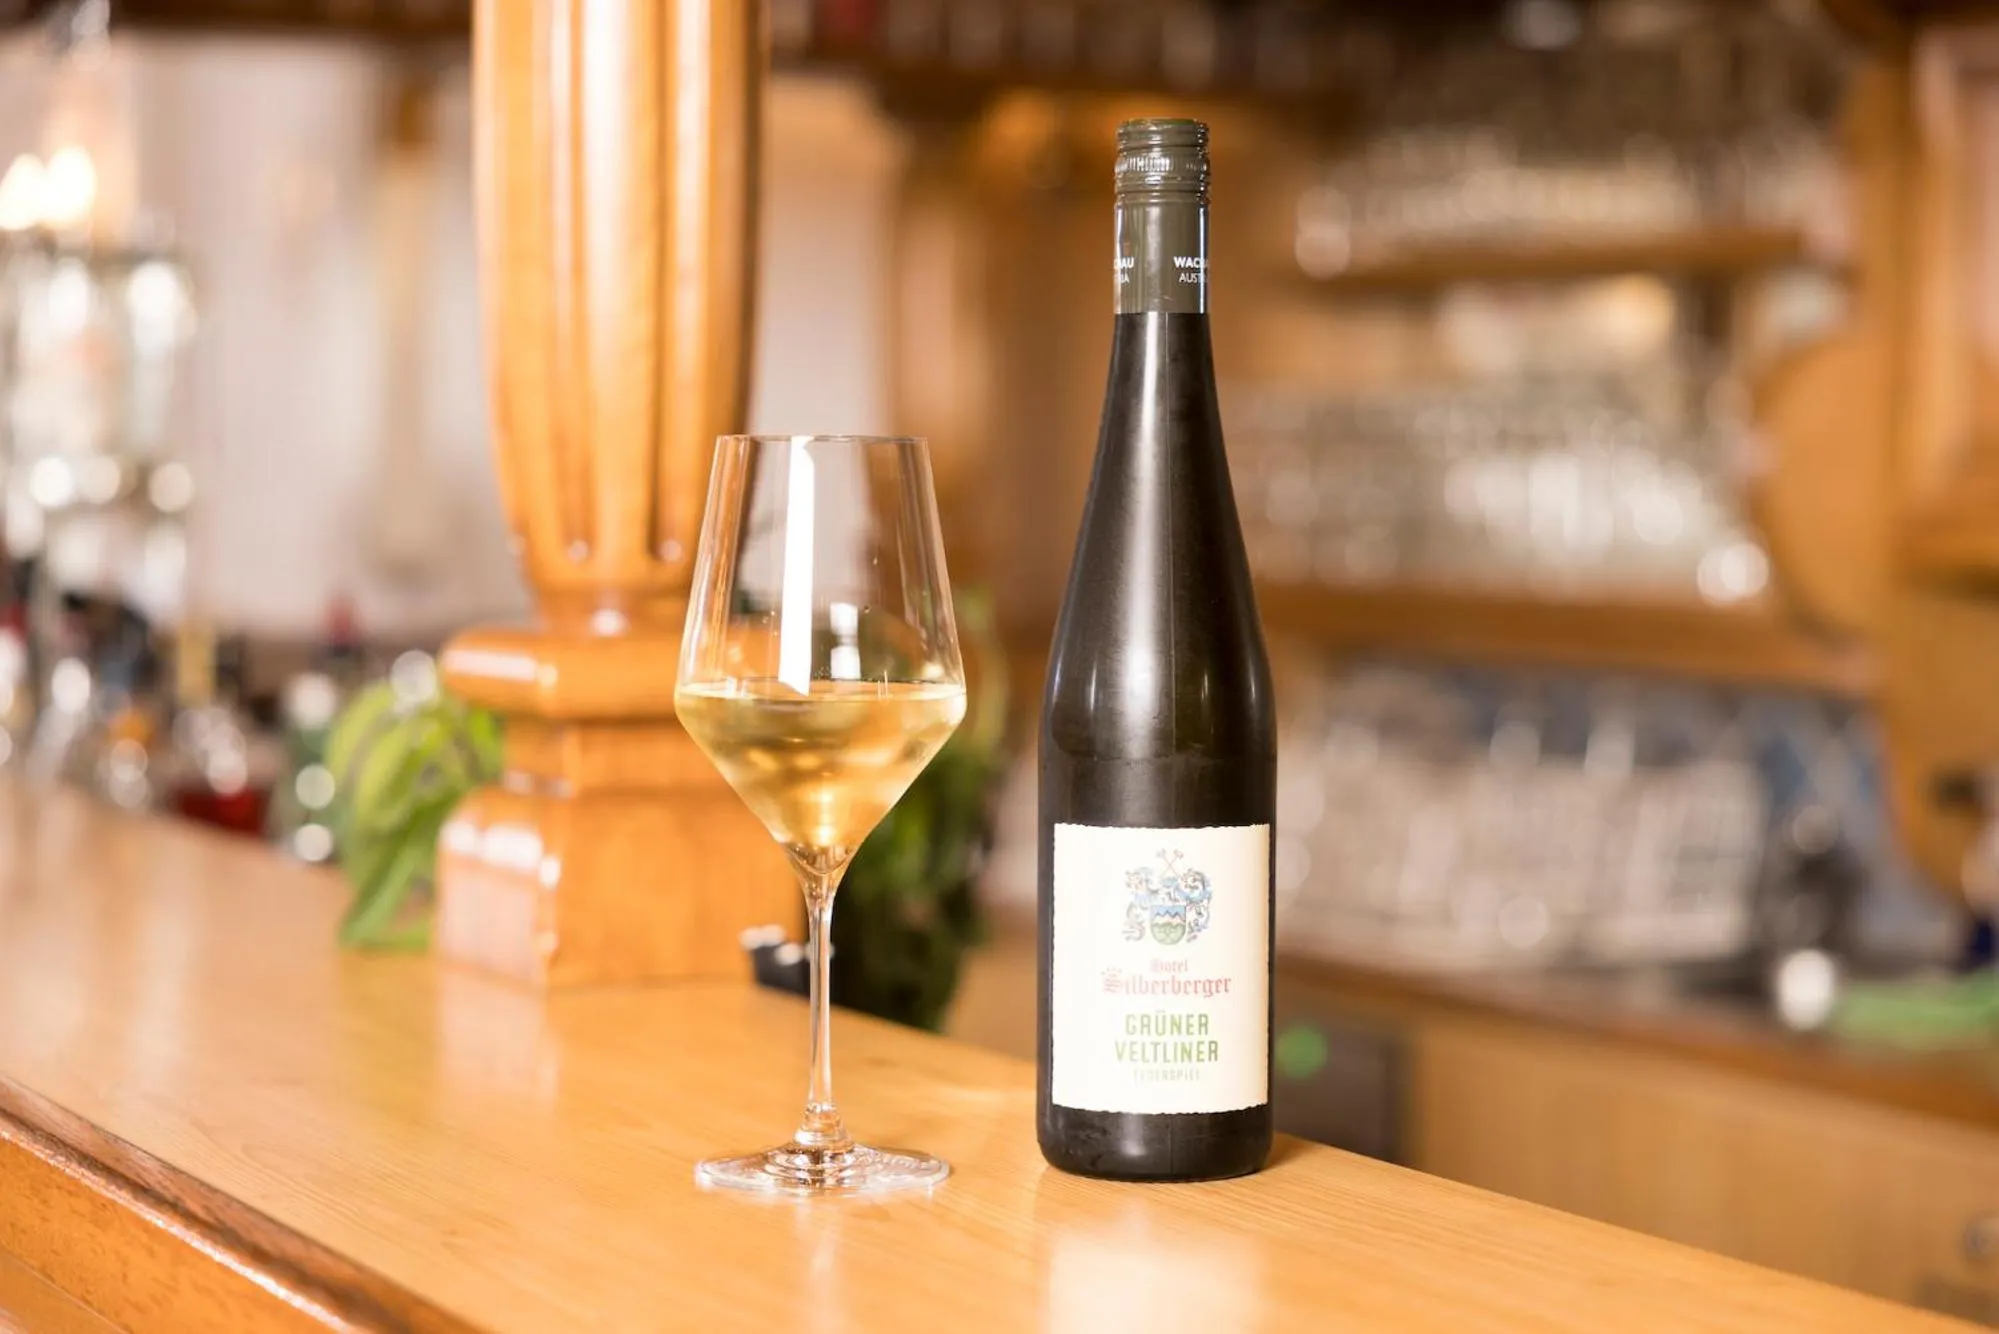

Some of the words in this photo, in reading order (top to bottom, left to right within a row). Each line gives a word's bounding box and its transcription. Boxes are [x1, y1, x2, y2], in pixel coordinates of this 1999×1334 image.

[1150, 957, 1189, 973] Hotel
[1101, 970, 1233, 999] Silberberger
[1125, 1009, 1209, 1037] GRÜNER
[1114, 1040, 1219, 1064] VELTLINER
